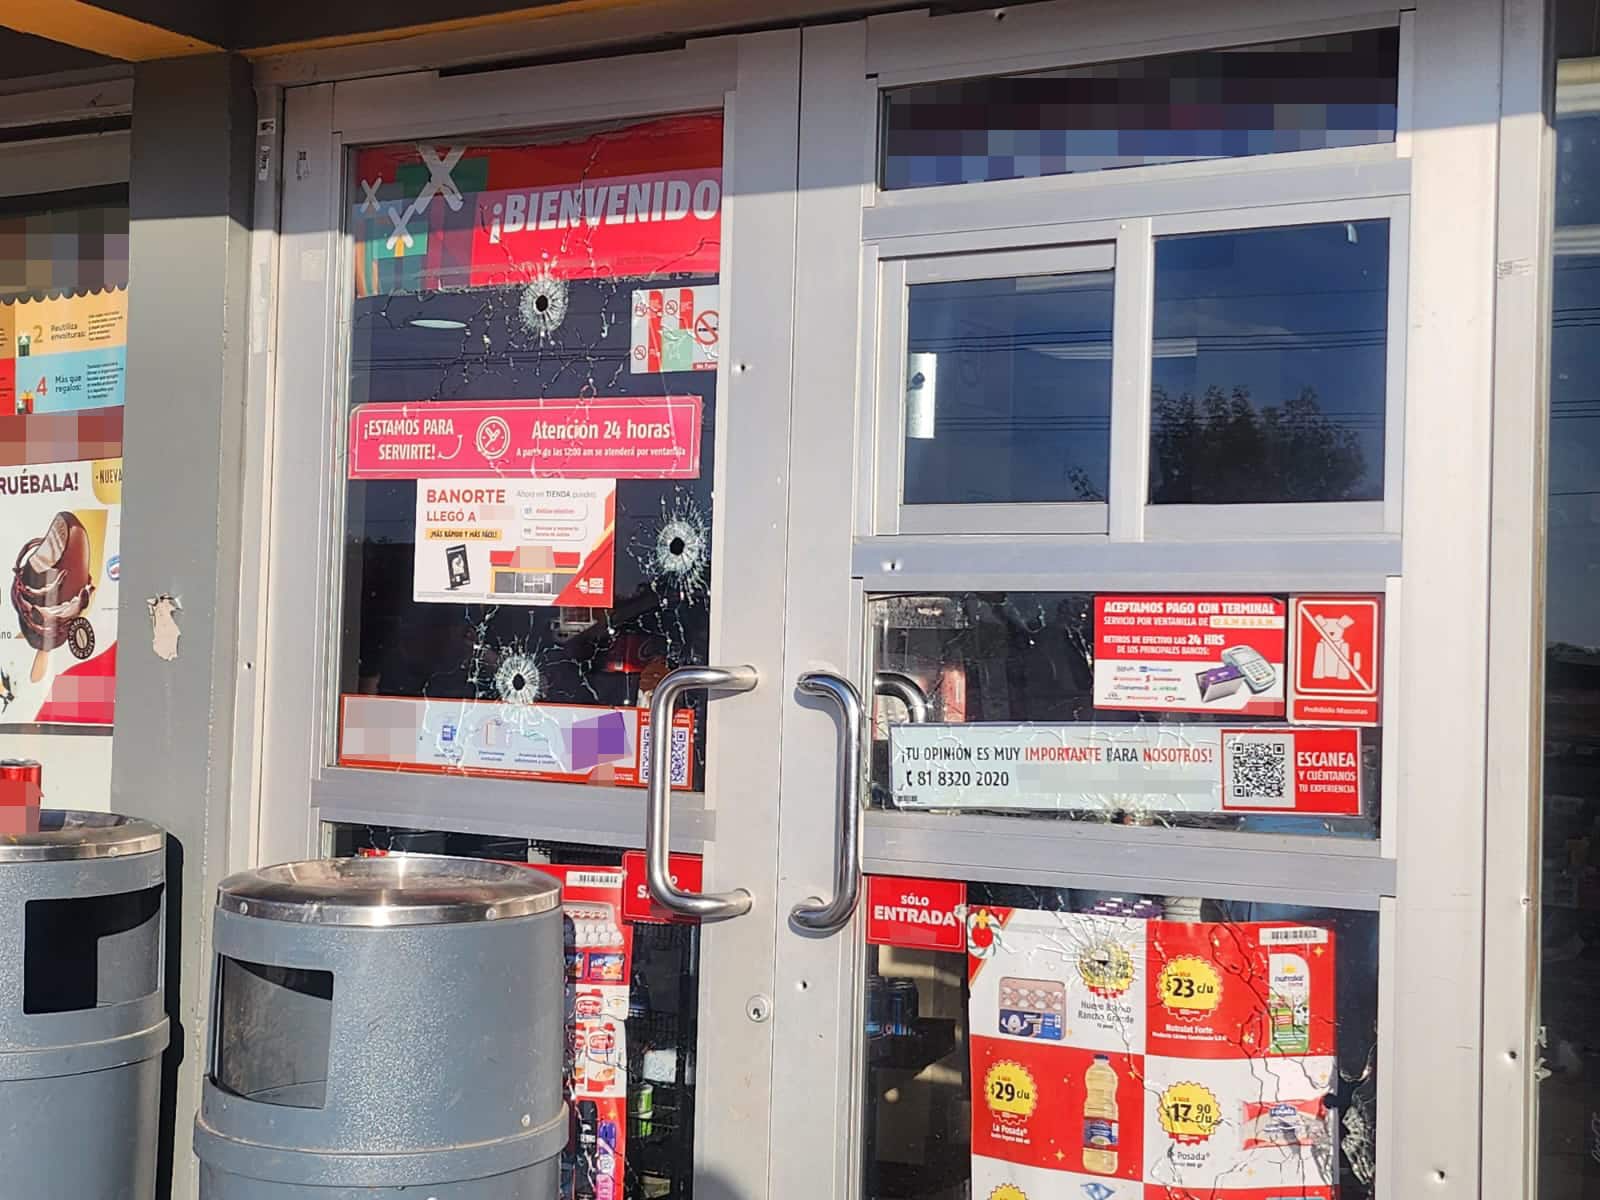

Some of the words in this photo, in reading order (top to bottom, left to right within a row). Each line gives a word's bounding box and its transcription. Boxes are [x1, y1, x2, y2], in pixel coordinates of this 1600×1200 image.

[33, 325, 43, 343] 2
[36, 376, 48, 396] 4
[364, 419, 420, 440] ¡ESTAMOS
[424, 419, 454, 435] PARA
[531, 420, 598, 439] Atención
[603, 421, 621, 439] 24
[627, 419, 671, 438] horas
[378, 444, 436, 460] SERVIRTE!
[516, 448, 521, 456] A
[552, 448, 563, 456] las
[604, 446, 635, 456] atenderá
[637, 449, 648, 457] por
[427, 489, 506, 503] BANORTE
[546, 490, 570, 498] TIENDA
[426, 508, 465, 521] LLEGÓ
[468, 511, 476, 521] A
[1104, 601, 1163, 614] ACEPTAMOS
[1166, 602, 1195, 614] PAGO
[1198, 602, 1219, 614] CON
[1222, 603, 1275, 615] TERMINAL
[1104, 616, 1135, 625] SERVICIO
[1137, 617, 1151, 625] POR
[1198, 618, 1208, 626] DE
[0, 631, 12, 640] no
[1188, 634, 1201, 645] 24
[1204, 634, 1225, 645] HRS
[924, 743, 972, 761] OPINIÓN
[977, 747, 989, 761] ES
[994, 747, 1020, 761] MUY
[1025, 747, 1101, 761] IMPORTANTE
[1107, 748, 1138, 762] PARA
[1143, 748, 1212, 763] NOSOTROS!
[1297, 751, 1356, 767] ESCANEA
[917, 771, 932, 786] 81
[938, 771, 971, 786] 8320
[976, 772, 1009, 786] 2020
[1298, 770, 1305, 780] Y
[1307, 768, 1356, 781] CUÉNTANOS
[1299, 784, 1308, 792] TU
[901, 893, 929, 906] SÓLO
[874, 905, 956, 927] ENTRADA
[1197, 983, 1214, 993] c/u
[1017, 1089, 1030, 1100] c/u
